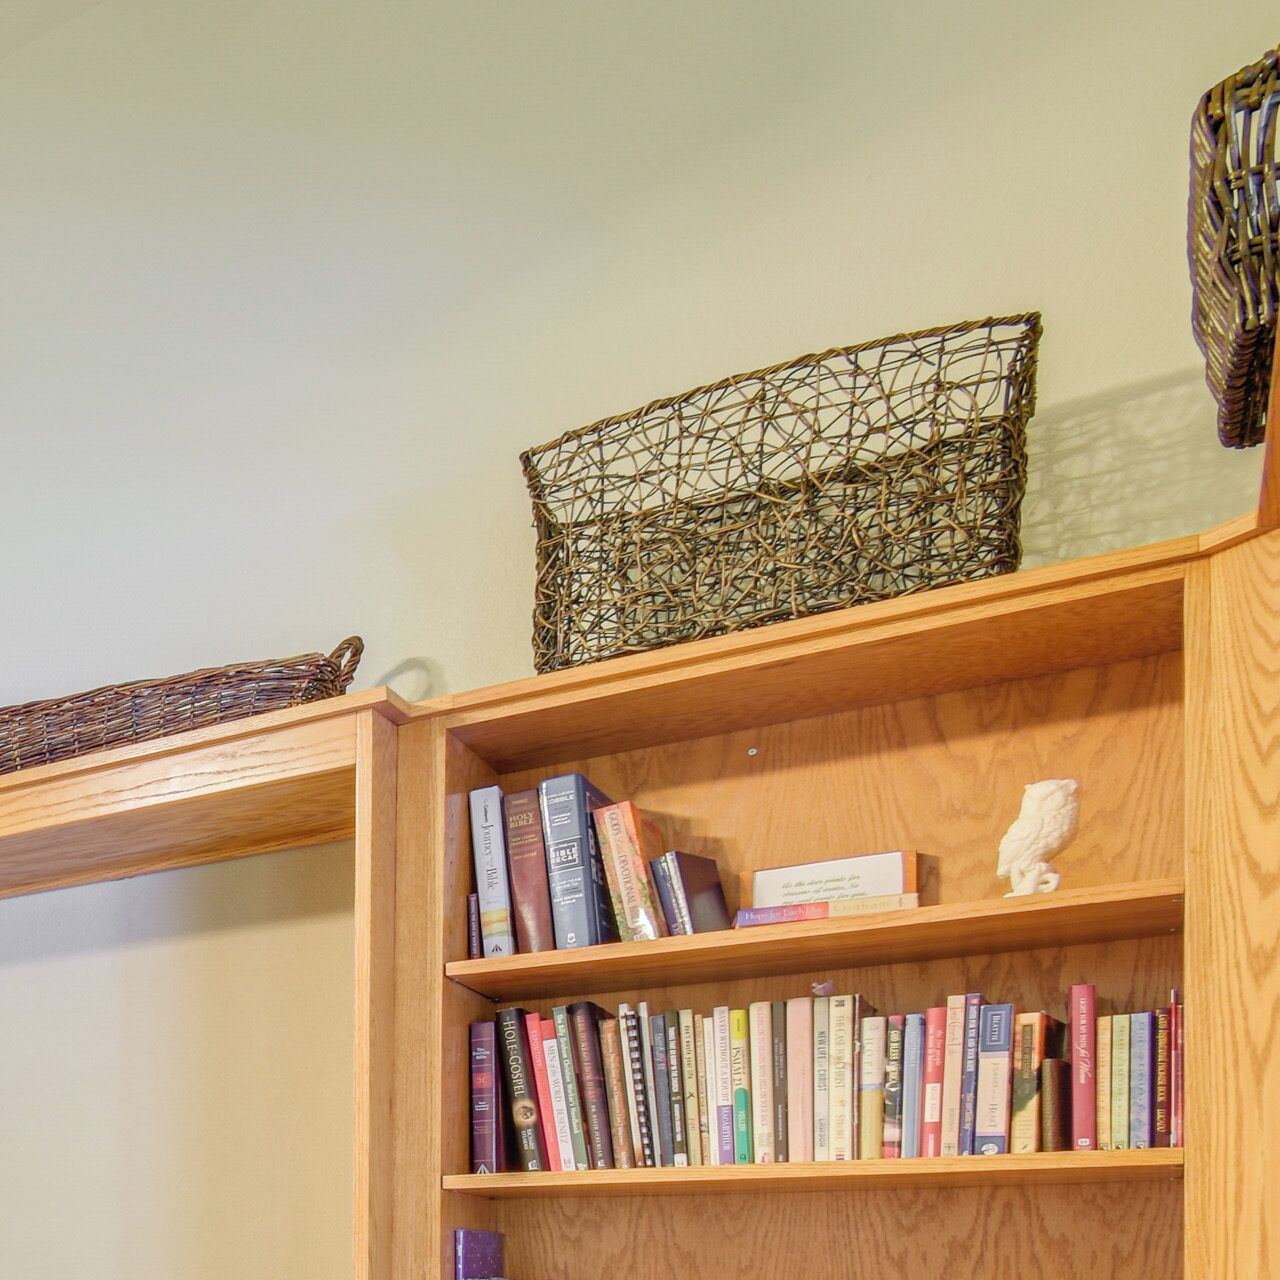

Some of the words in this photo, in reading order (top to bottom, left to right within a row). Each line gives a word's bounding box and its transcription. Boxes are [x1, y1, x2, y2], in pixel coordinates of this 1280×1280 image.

[510, 812, 534, 822] HOLY
[510, 818, 534, 828] BIBLE
[551, 848, 577, 857] BIBLE
[551, 854, 578, 864] RECAP
[487, 867, 497, 891] Bible
[745, 911, 766, 922] Hope
[556, 1025, 565, 1036] Billy
[835, 1016, 845, 1027] THE
[991, 1015, 1001, 1041] BEATTIE
[503, 1021, 519, 1051] HOLE
[835, 1029, 845, 1049] CASE
[547, 1045, 556, 1062] MEN
[559, 1038, 567, 1057] Graham
[720, 1037, 728, 1069] WITHOUT
[818, 1047, 826, 1059] LIFE
[562, 1059, 571, 1082] Christian
[684, 1057, 692, 1068] your
[732, 1047, 741, 1075] PSALM
[509, 1055, 524, 1097] GOSPEL
[686, 1070, 694, 1079] life
[734, 1077, 742, 1087] 23
[818, 1069, 826, 1091] CHRIST
[551, 1079, 561, 1101] WORD
[565, 1084, 574, 1106] Worker's
[721, 1078, 729, 1103] DOUBT
[569, 1108, 578, 1134] Handbook
[1157, 1109, 1165, 1132] LUCADO
